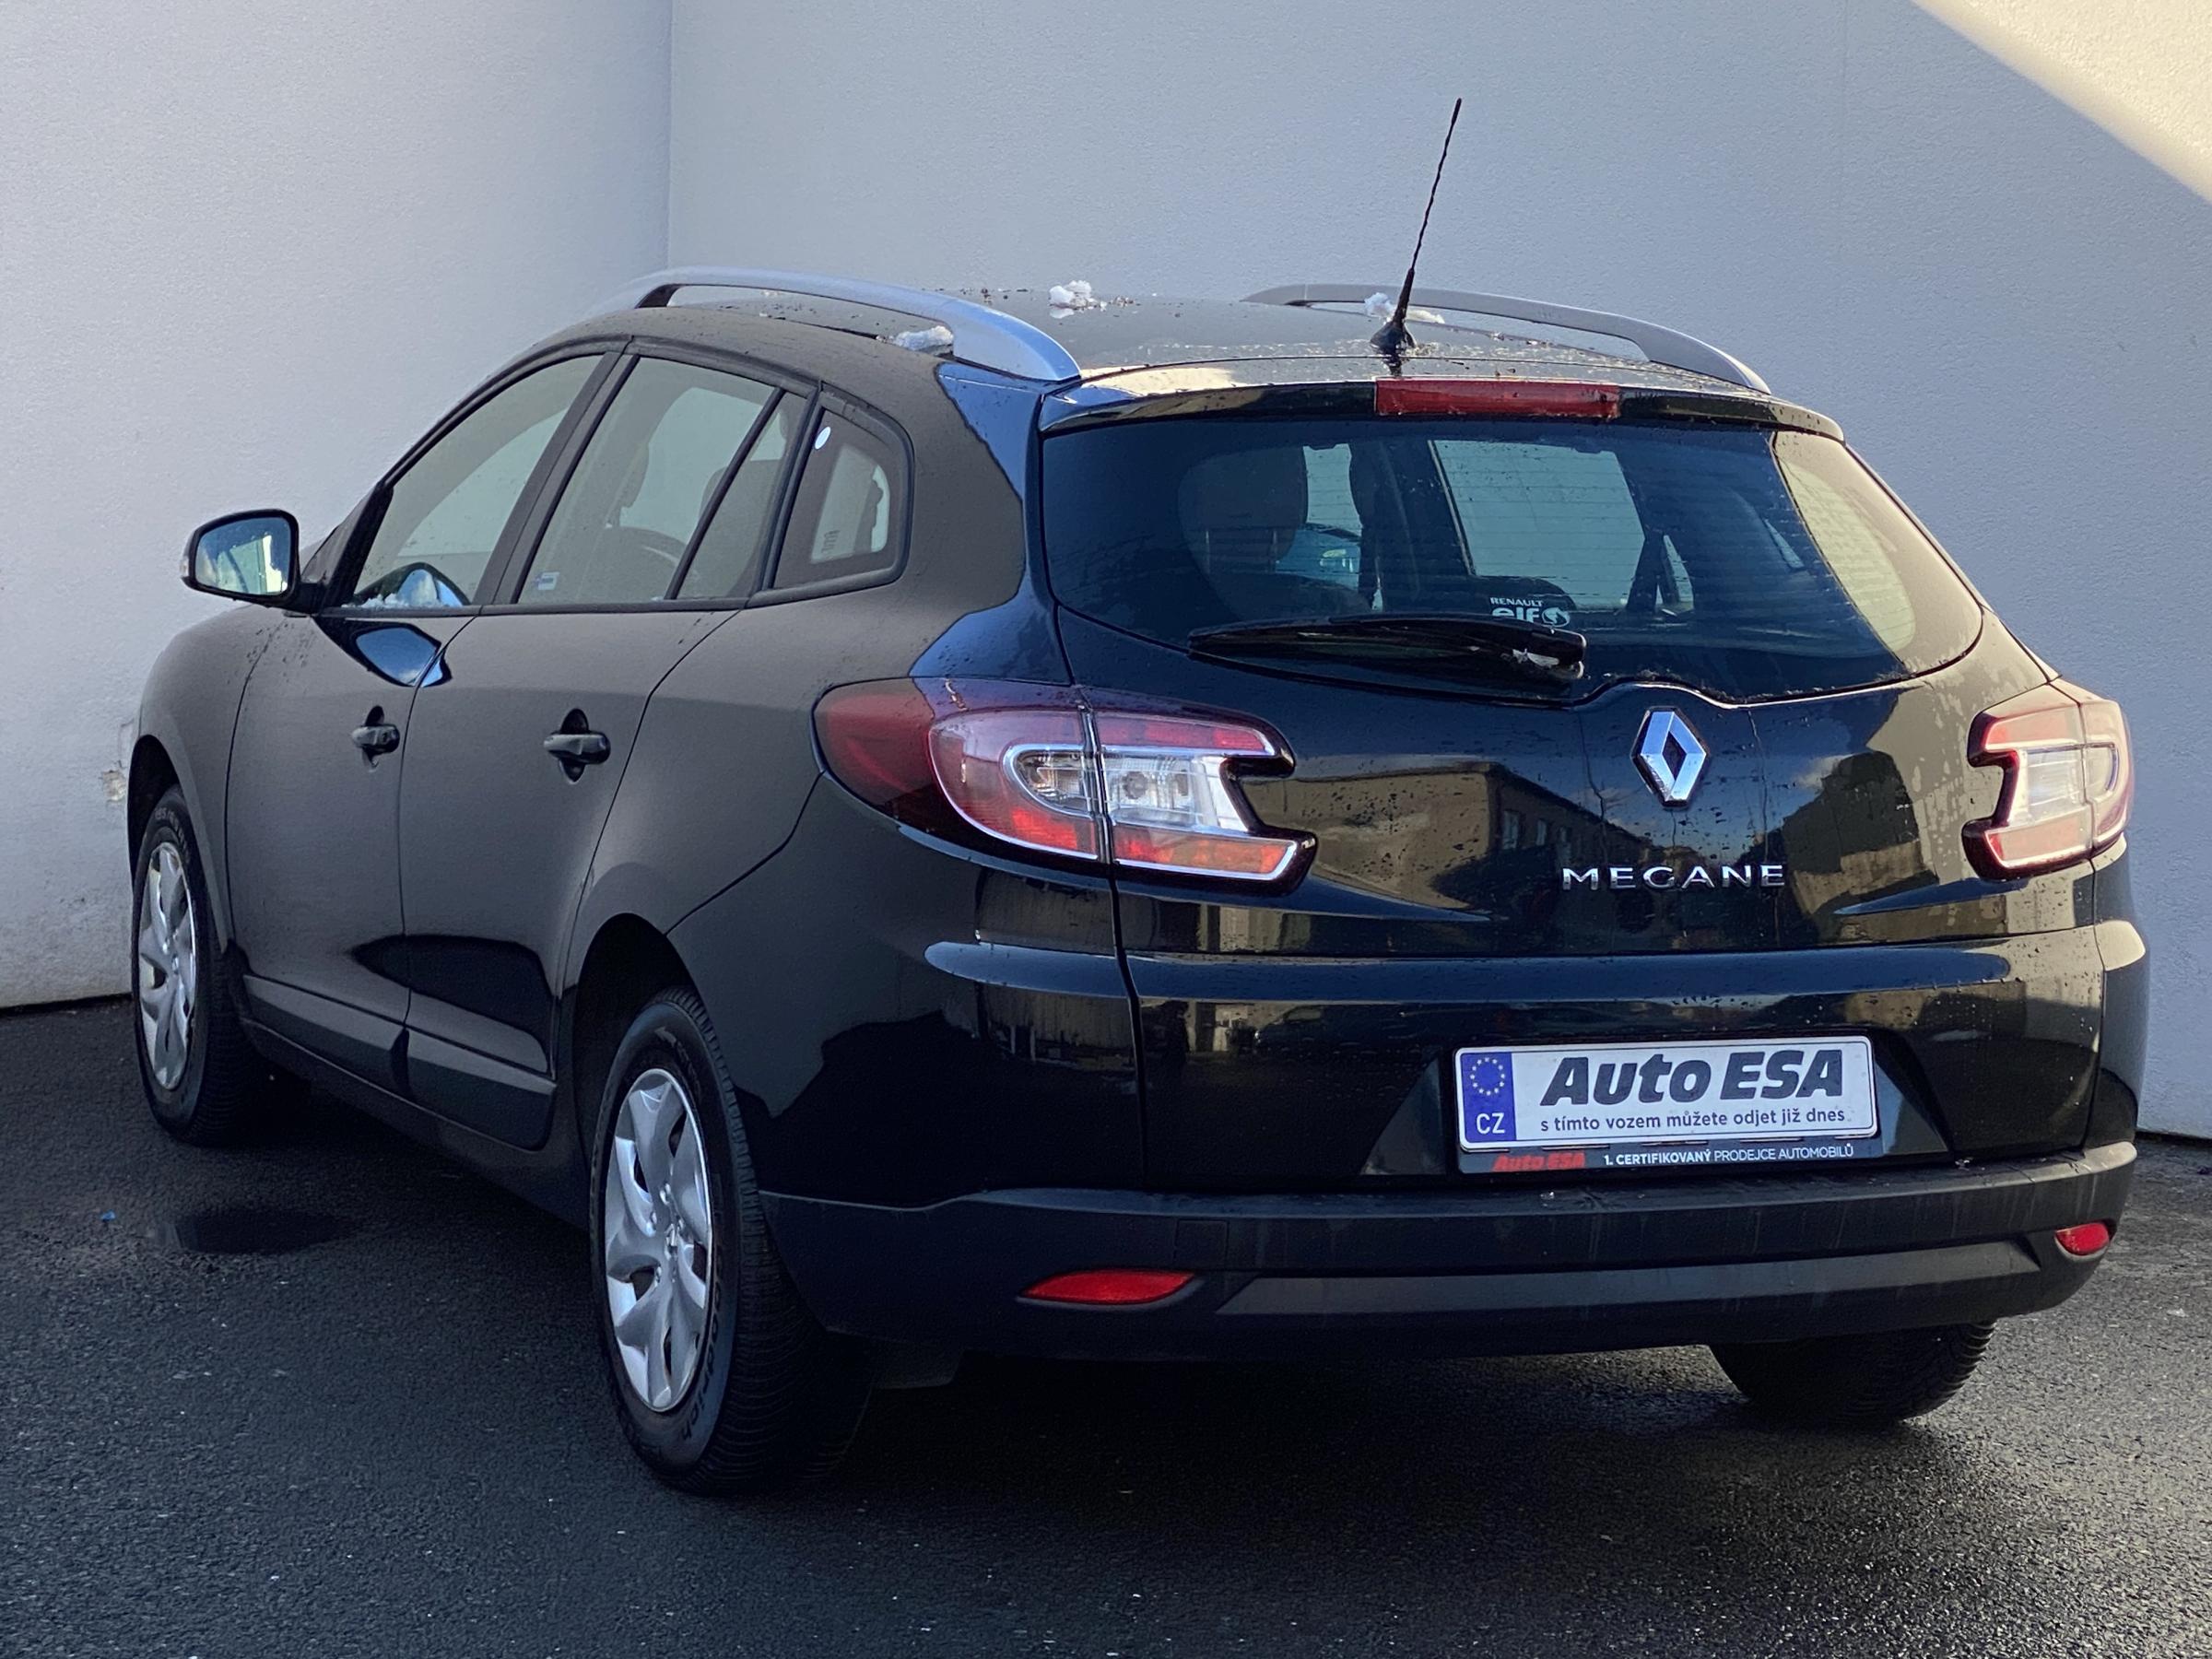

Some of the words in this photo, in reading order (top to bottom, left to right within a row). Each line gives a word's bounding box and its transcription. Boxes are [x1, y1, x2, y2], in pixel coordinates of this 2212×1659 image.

[1490, 597, 1543, 606] RENAULT
[1562, 865, 1785, 890] MEGANE
[1539, 1053, 1712, 1106] Auto
[1720, 1049, 1842, 1100] ESA
[1476, 1112, 1505, 1134] CZ
[1540, 1120, 1549, 1132] s
[1554, 1115, 1600, 1131] tímto
[1606, 1116, 1660, 1129] vozem
[1666, 1111, 1728, 1127] můžete
[1733, 1109, 1777, 1127] odjet
[1781, 1108, 1801, 1126] již
[1806, 1108, 1845, 1124] dnes
[1492, 1154, 1545, 1172] Auto
[1547, 1150, 1586, 1171] ESA
[1604, 1154, 1613, 1166] 1.
[1616, 1148, 1712, 1166] CERTIFIKOVANÝ
[1713, 1147, 1777, 1162] PRODEJCE
[1778, 1143, 1854, 1160] AUTOMOBILŮ
